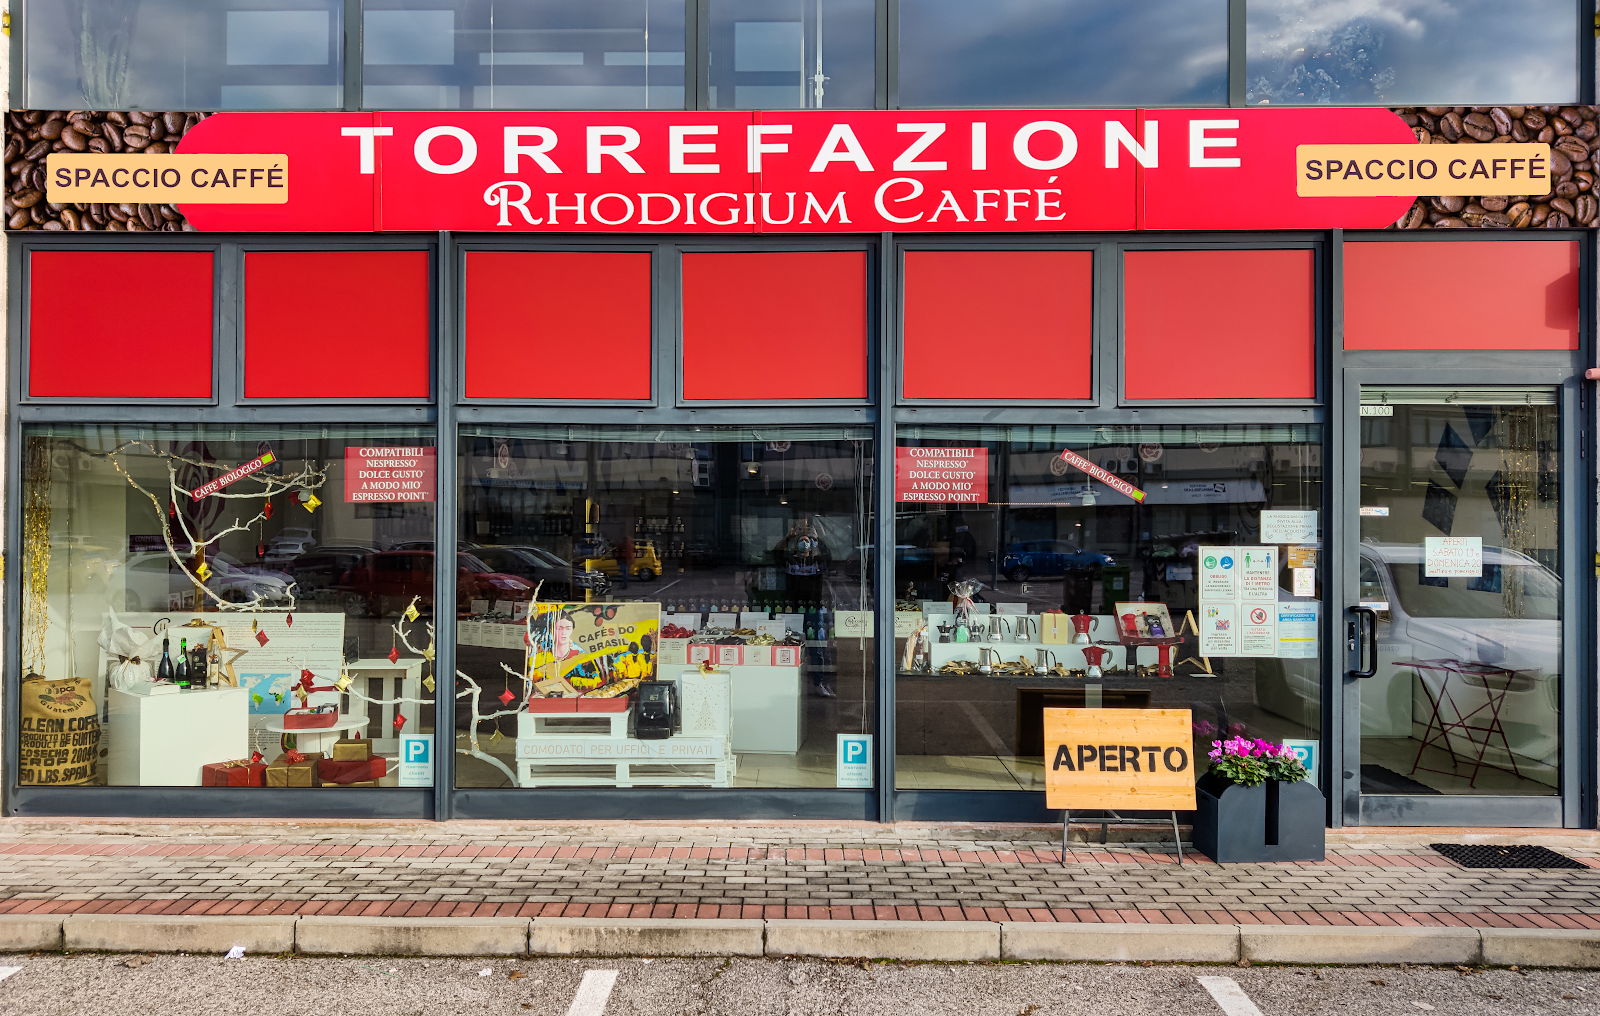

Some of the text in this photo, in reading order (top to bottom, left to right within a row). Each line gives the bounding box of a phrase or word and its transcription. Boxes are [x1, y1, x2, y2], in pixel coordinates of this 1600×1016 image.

[340, 118, 1242, 175] TORREFAZIONE
[1305, 152, 1546, 182] SPACCIO CAFFÉ
[54, 163, 285, 189] SPACCIO CAFFÉ
[359, 447, 424, 457] COMPATIBILI
[909, 448, 974, 458] COMPATIBILI
[218, 459, 262, 487] BIOLOGICO
[359, 470, 390, 479] DOLCE
[909, 470, 940, 479] DOLCE
[361, 481, 368, 490] A
[370, 481, 400, 490] MODO
[911, 481, 918, 490] A
[920, 482, 950, 491] MODO
[1088, 467, 1133, 495] BIOLOGICO
[352, 492, 395, 501] ESPRESSO
[902, 492, 946, 501] ESPRESSO
[1432, 548, 1463, 557] SABATO
[1427, 559, 1470, 568] DOMENICA
[618, 625, 635, 635] DO
[588, 638, 629, 653] BRASIL
[61, 733, 72, 741] DE
[409, 741, 425, 761] P
[523, 744, 713, 755] COMODATO PER UFFICI E PRIVATI
[847, 741, 863, 762] P
[1052, 744, 1189, 773] APERTO
